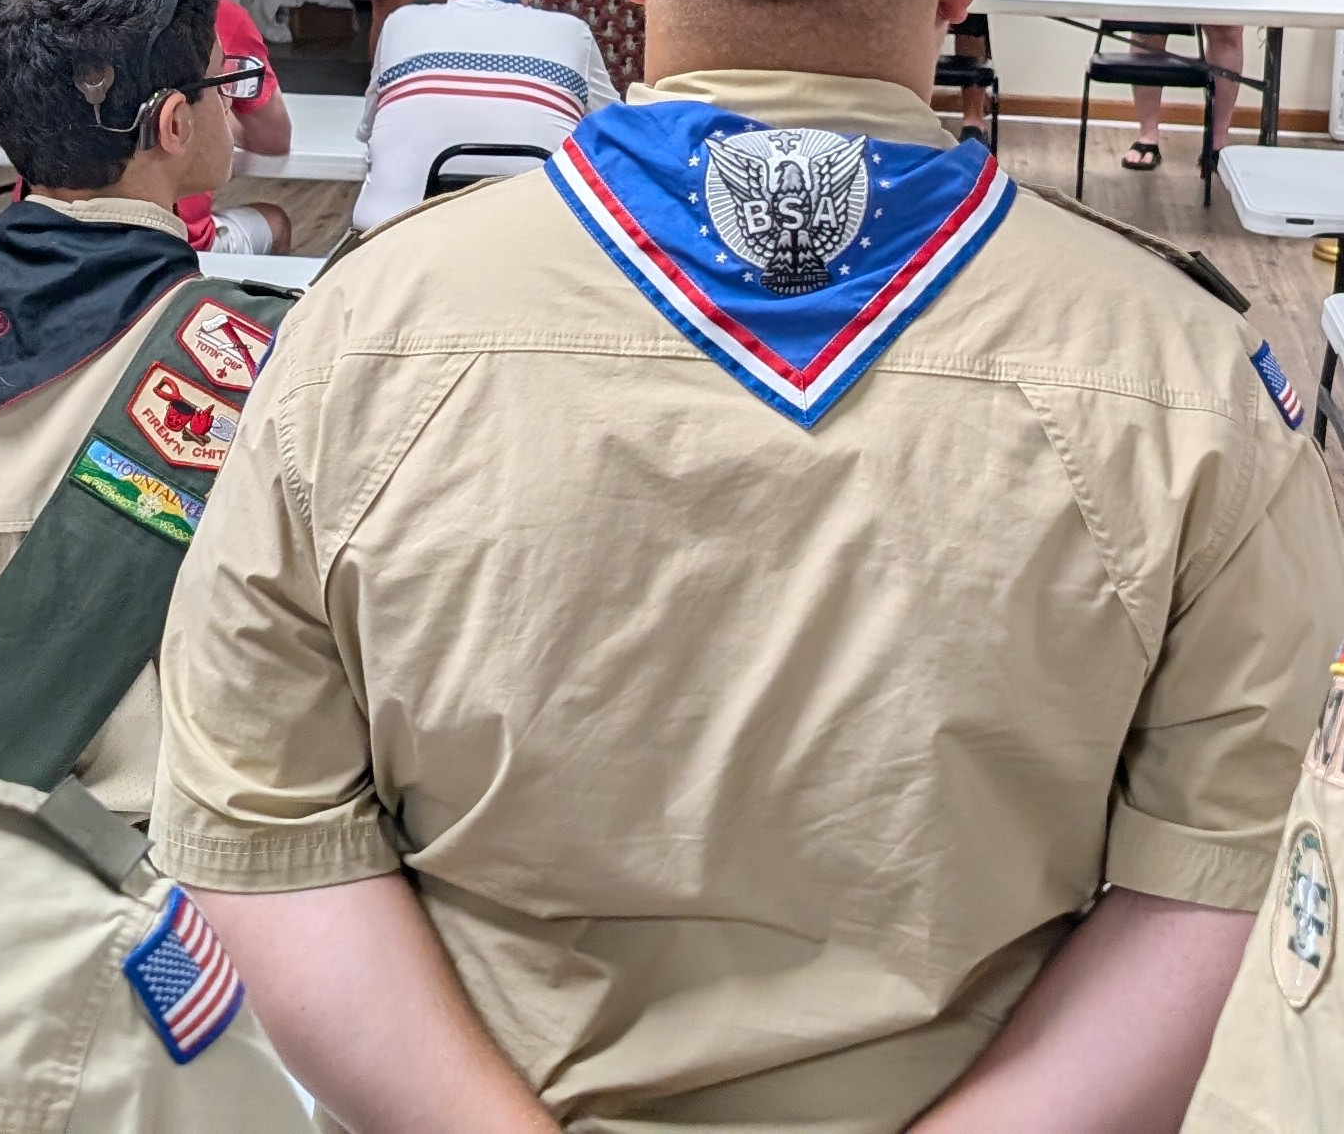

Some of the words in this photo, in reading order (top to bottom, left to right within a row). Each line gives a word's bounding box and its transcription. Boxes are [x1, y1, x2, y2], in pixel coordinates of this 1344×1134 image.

[743, 196, 839, 235] BSA
[223, 356, 243, 371] CHIP
[192, 447, 226, 460] CHIT
[103, 452, 205, 518] MOUNTAINEE
